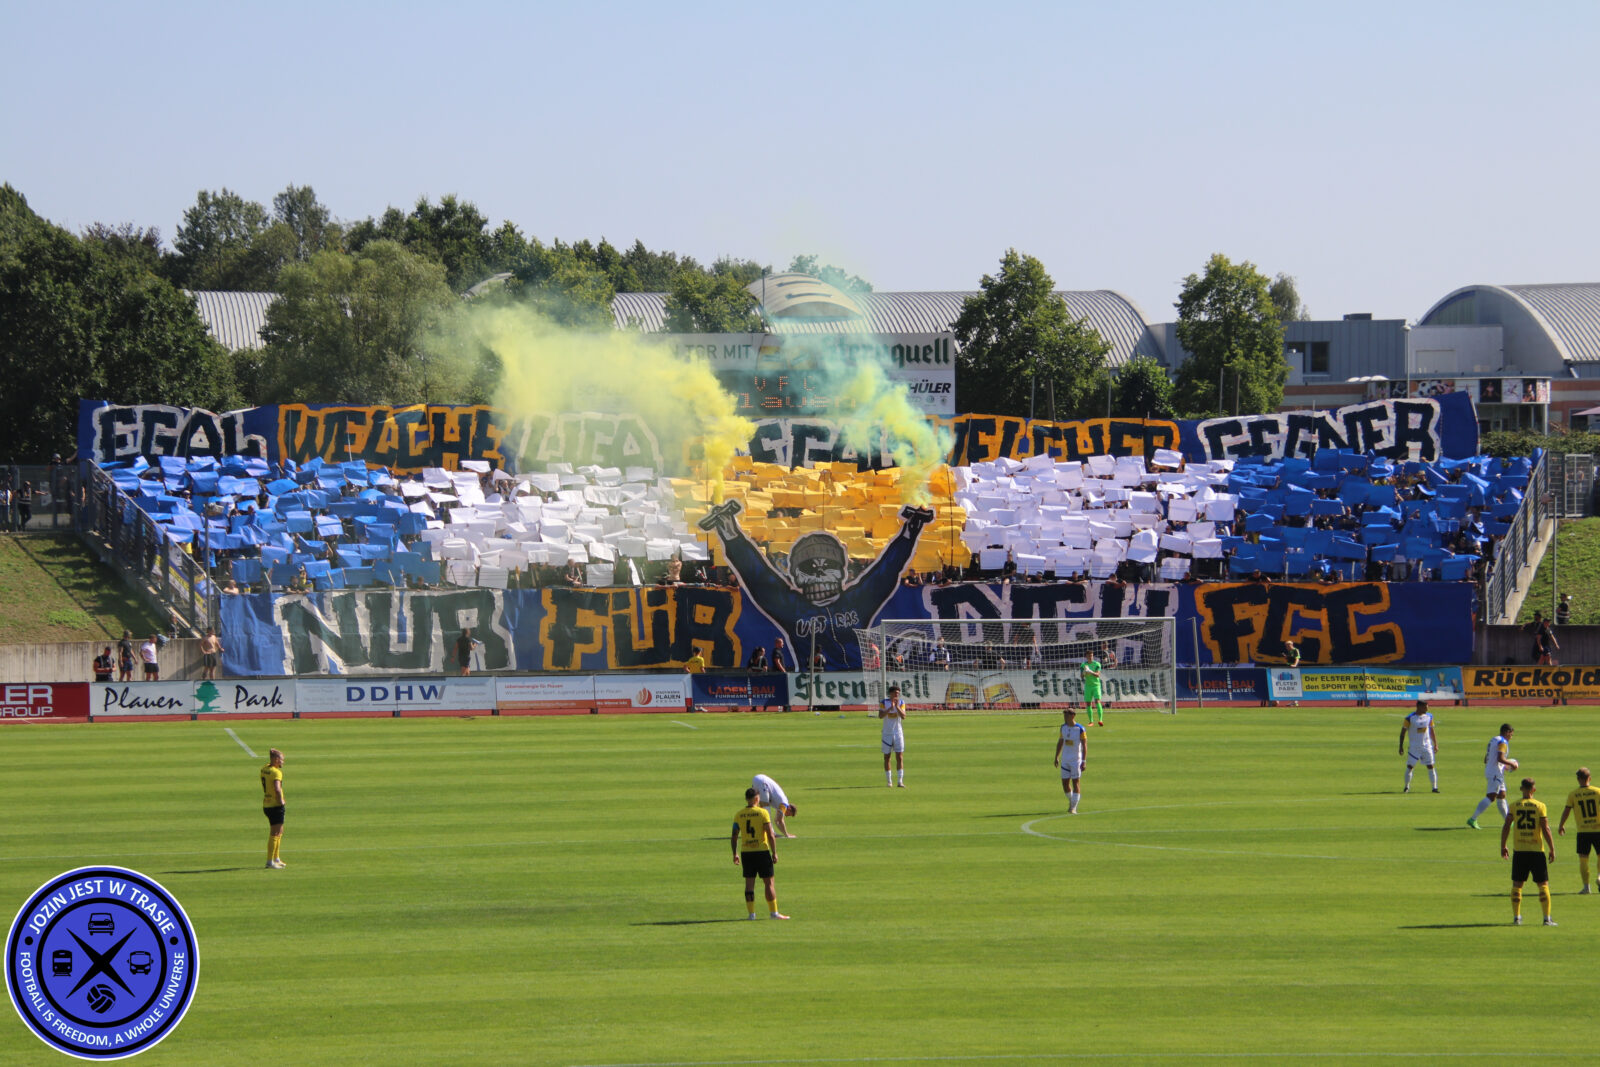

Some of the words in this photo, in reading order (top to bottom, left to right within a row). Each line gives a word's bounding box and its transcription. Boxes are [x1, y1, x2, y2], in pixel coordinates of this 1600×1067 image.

[724, 345, 752, 359] MIT
[905, 378, 951, 394] HÜLER
[736, 392, 856, 408] lauen
[93, 404, 267, 467] EGAL
[278, 403, 508, 474] WELCHE
[1197, 398, 1441, 463] GEGNER
[273, 588, 517, 675] NUR
[540, 587, 742, 670] FÜR
[922, 582, 1178, 666] DICH
[1195, 581, 1405, 665] FCC
[346, 685, 446, 702] DDHW
[708, 685, 747, 695] LADEN
[752, 685, 776, 694] BAU
[1032, 670, 1168, 701] Stequell
[1232, 680, 1255, 688] BAU
[1501, 689, 1562, 698] PEUGEOT
[0, 685, 53, 706] ER
[104, 687, 184, 711] Plauen
[235, 685, 283, 709] Park
[1578, 799, 1597, 818] 10
[746, 819, 756, 838] 4
[1516, 810, 1536, 830] 25
